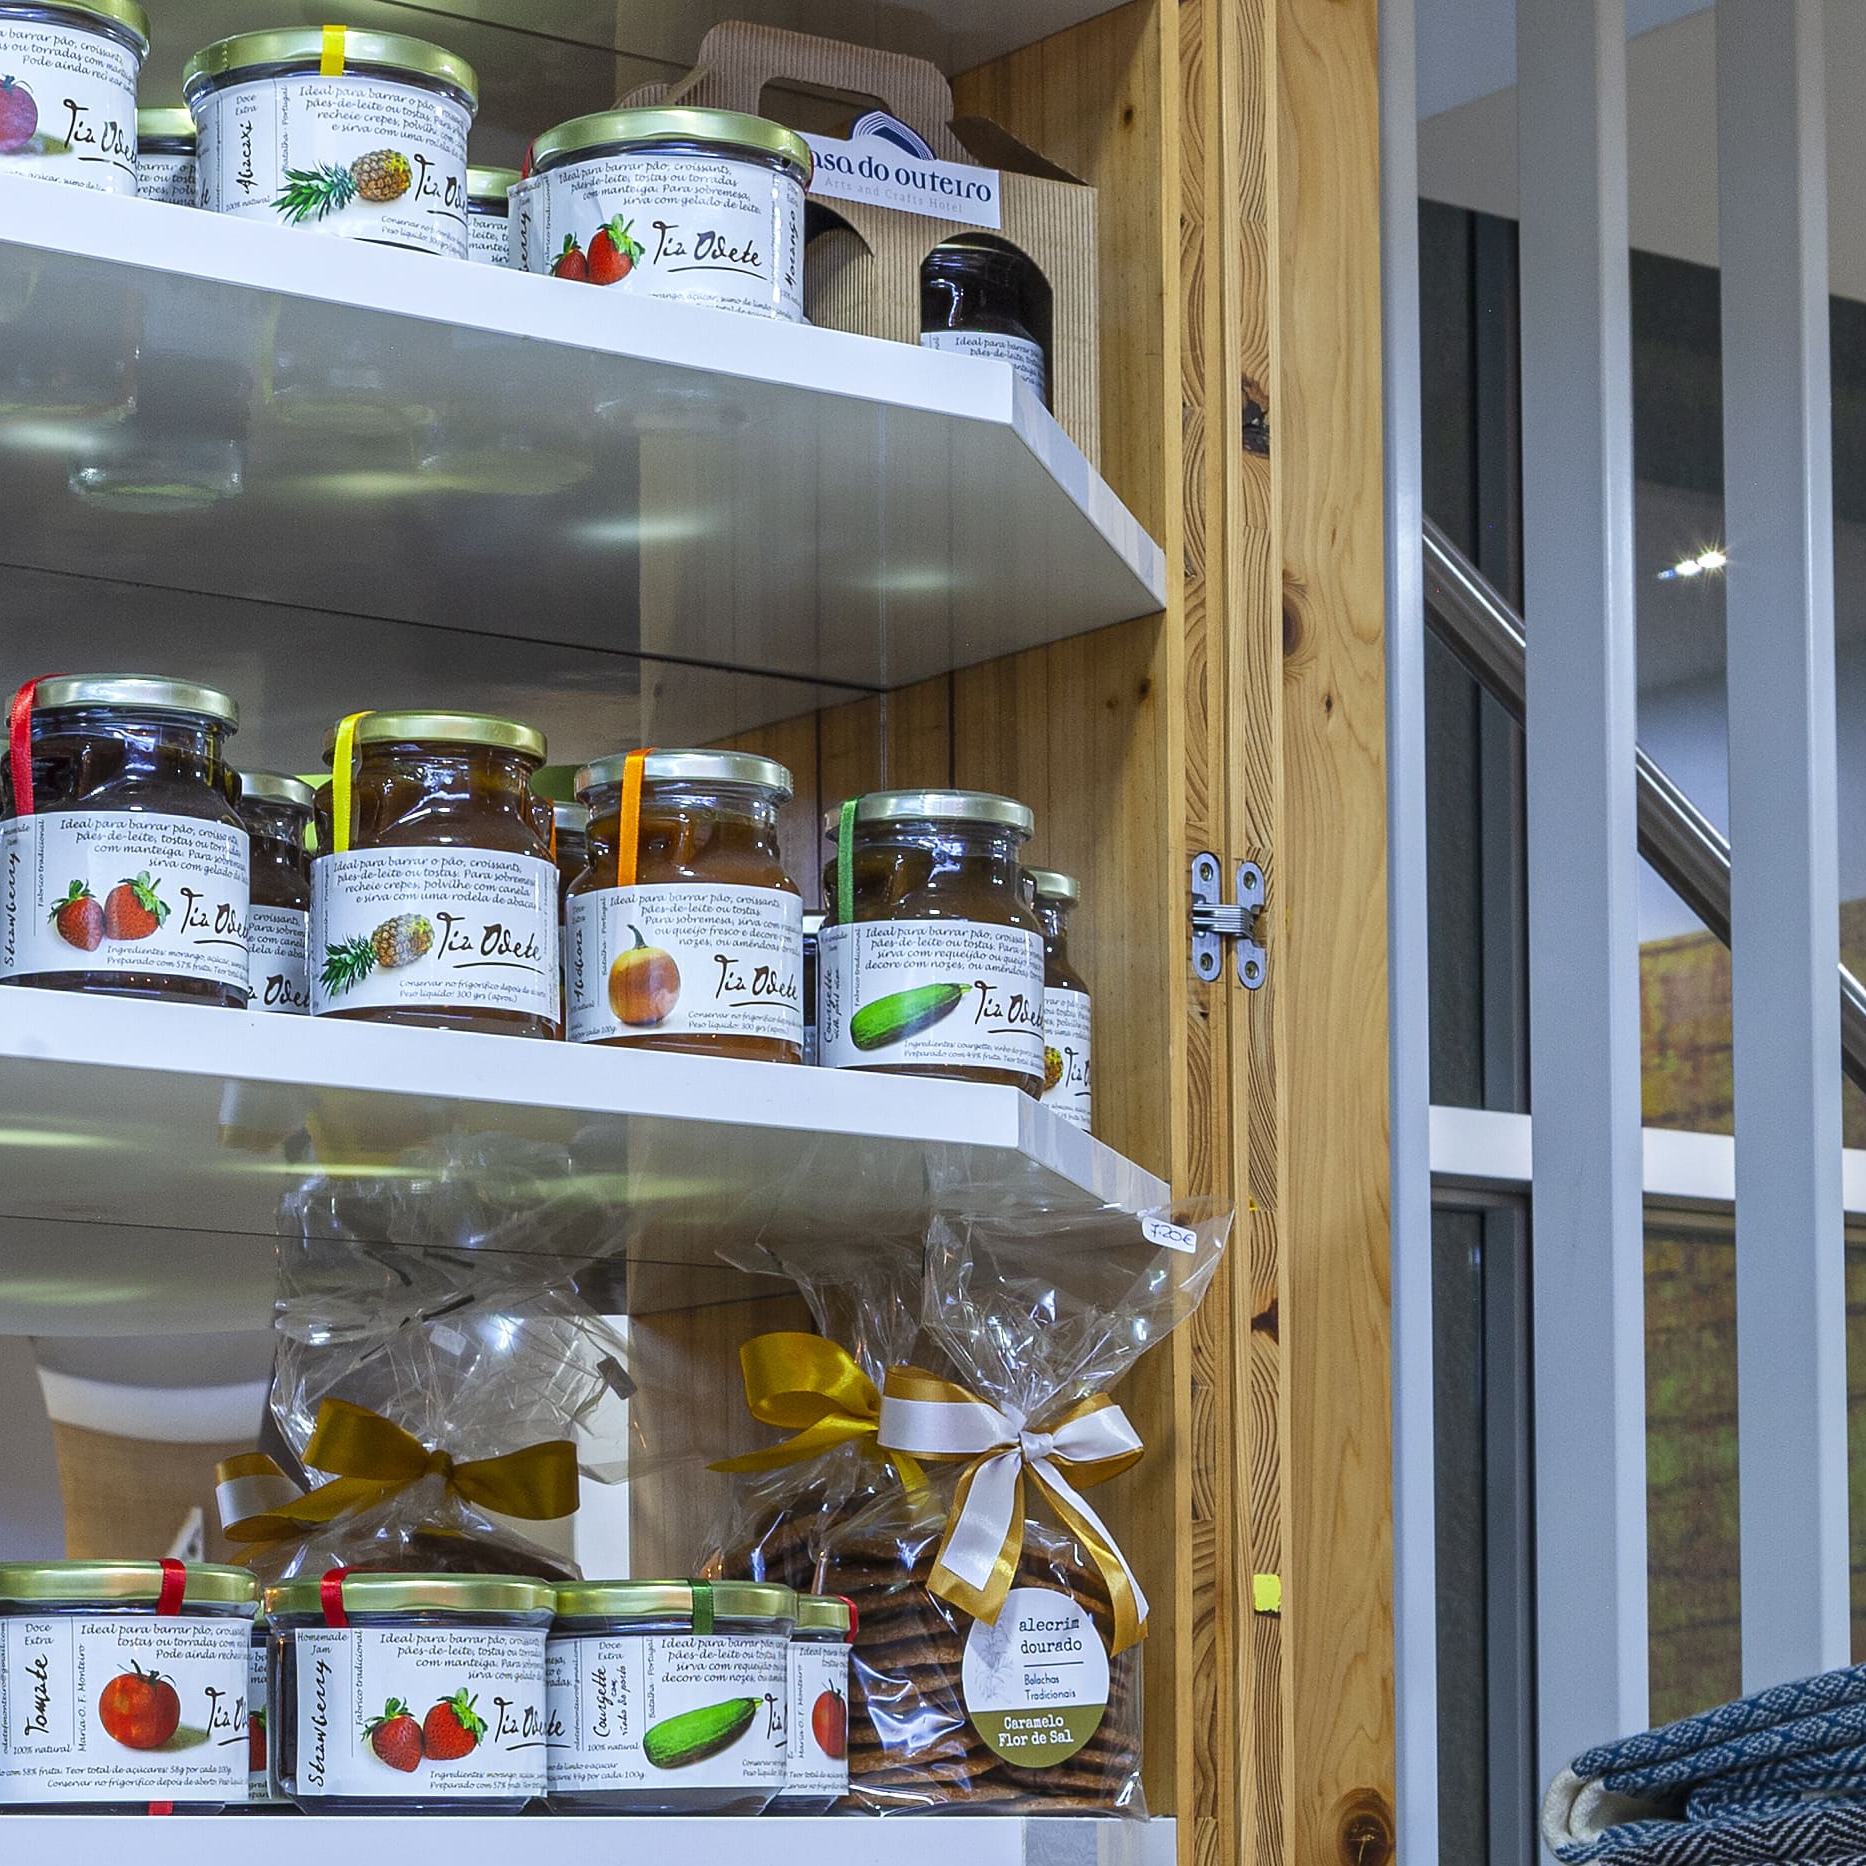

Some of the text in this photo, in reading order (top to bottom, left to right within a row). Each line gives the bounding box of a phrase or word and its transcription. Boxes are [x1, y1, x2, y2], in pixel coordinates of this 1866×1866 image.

[63, 98, 96, 148] Tia
[812, 149, 992, 202] asa do outeiro
[824, 176, 964, 214] Arts and Crafts Hotel
[652, 221, 763, 268] Tia Odete
[60, 819, 171, 836] Ideal para barrar
[181, 888, 208, 935] Tia
[437, 912, 541, 962] Tia Odete
[714, 954, 746, 999] Tia
[974, 980, 1003, 1024] Tia
[25, 1623, 53, 1633] Doce
[81, 1624, 191, 1640] Ideal para barrar
[1019, 1618, 1080, 1632] alecrim
[24, 1635, 54, 1646] Extra
[117, 1636, 217, 1648] tostas ou torradas
[298, 1632, 348, 1642] Homemade
[311, 1645, 332, 1655] Jam
[599, 1641, 622, 1650] Doce
[1021, 1638, 1083, 1654] dourado
[598, 1652, 623, 1661] Extra
[1024, 1674, 1059, 1685] Bolachas
[24, 1653, 52, 1737] Tomate
[78, 1644, 87, 1752] Maria Monteiro
[1024, 1689, 1076, 1701] Tradicionais
[205, 1687, 230, 1737] Tia
[494, 1697, 519, 1743] Tia
[309, 1658, 332, 1788] Strawberry
[1004, 1714, 1064, 1730] Caramelo
[998, 1729, 1074, 1747] Flor de Sal
[35, 1743, 73, 1755] natural
[608, 1742, 640, 1751] natural
